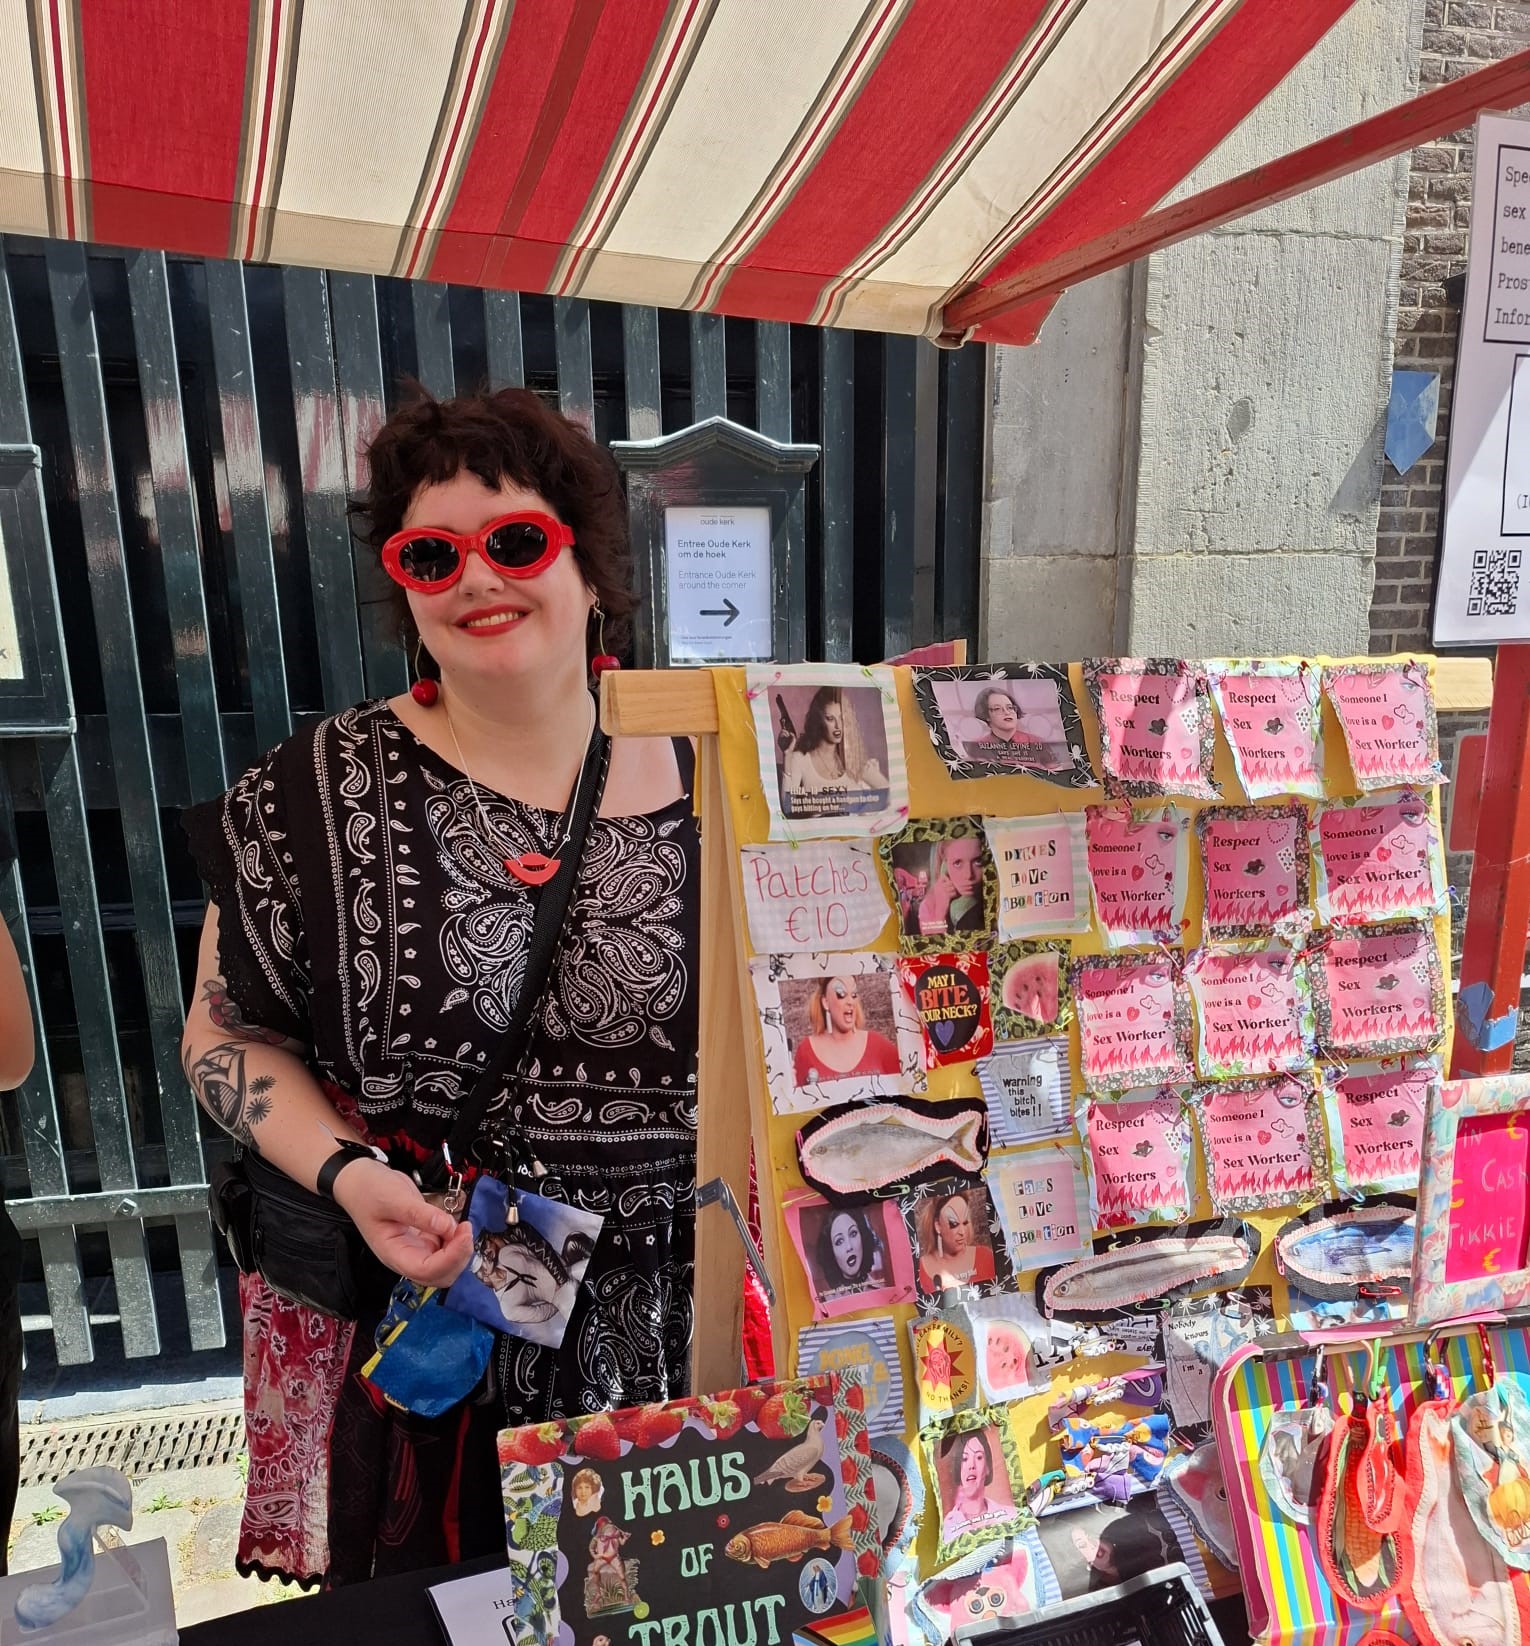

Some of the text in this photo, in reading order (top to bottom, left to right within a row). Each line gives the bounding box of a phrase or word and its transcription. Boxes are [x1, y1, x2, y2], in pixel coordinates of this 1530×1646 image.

[1505, 166, 1530, 187] Spe
[1503, 205, 1526, 220] sex
[1497, 272, 1530, 290] Pros
[1517, 494, 1530, 509] (I
[678, 540, 751, 548] Entree Oude Kerk
[694, 550, 704, 558] de
[706, 550, 726, 558] hoek
[679, 581, 705, 589] around
[708, 581, 720, 589] the
[1110, 690, 1160, 706] Respect
[1229, 692, 1276, 705] Respect
[1340, 694, 1381, 705] Someone
[1115, 717, 1135, 729] Sex
[1233, 718, 1252, 730] Sex
[1362, 717, 1369, 726] is
[1355, 739, 1419, 750] Sex Worker
[1120, 745, 1172, 760] Workers
[1239, 747, 1286, 760] Workers
[823, 786, 848, 795] SEXY
[1323, 828, 1375, 840] Someone
[1213, 836, 1261, 848] Respect
[1005, 840, 1056, 861] DYKES
[1092, 844, 1135, 853] Someone
[1326, 852, 1346, 862] love
[1348, 851, 1358, 860] is
[1093, 867, 1109, 877] love
[1111, 867, 1118, 876] is
[1213, 862, 1231, 873] Sex
[750, 857, 867, 902] Patches
[1336, 870, 1422, 886] Sex Worker
[1100, 890, 1166, 902] Sex Worker
[1213, 889, 1265, 899] Workers
[785, 903, 848, 942] €10
[1334, 952, 1388, 968] Respect
[927, 974, 955, 989] MAY I
[1201, 975, 1246, 986] Someone
[1338, 980, 1361, 992] Sex
[919, 985, 970, 1010] BITE
[1085, 987, 1128, 1000] Someone
[1204, 1000, 1221, 1009] love
[1224, 998, 1232, 1007] is
[941, 1004, 977, 1020] NECK?
[1087, 1012, 1103, 1022] love
[1105, 1010, 1113, 1020] is
[1342, 1003, 1402, 1017] Workers
[1212, 1017, 1290, 1033] Sex Worker
[1093, 1029, 1166, 1046] Sex Worker
[1002, 1074, 1042, 1087] warning
[1008, 1088, 1024, 1096] this
[1346, 1087, 1399, 1103] Respect
[1014, 1096, 1035, 1105] bitch
[1210, 1111, 1258, 1123] Someone
[1350, 1116, 1373, 1128] Sex
[1096, 1118, 1145, 1131] Respect
[1213, 1134, 1231, 1145] love
[1234, 1133, 1242, 1143] is
[1098, 1144, 1119, 1156] Sex
[1354, 1139, 1414, 1155] Workers
[1223, 1151, 1301, 1169] Sex Worker
[1102, 1170, 1156, 1185] Workers
[1169, 1320, 1196, 1330] Nobody
[1184, 1330, 1208, 1340] knows
[1182, 1364, 1194, 1372] I'm
[621, 1451, 751, 1520] HAUS
[679, 1544, 714, 1577] OF
[493, 1598, 516, 1610] Ha
[628, 1594, 785, 1646] TROUT
